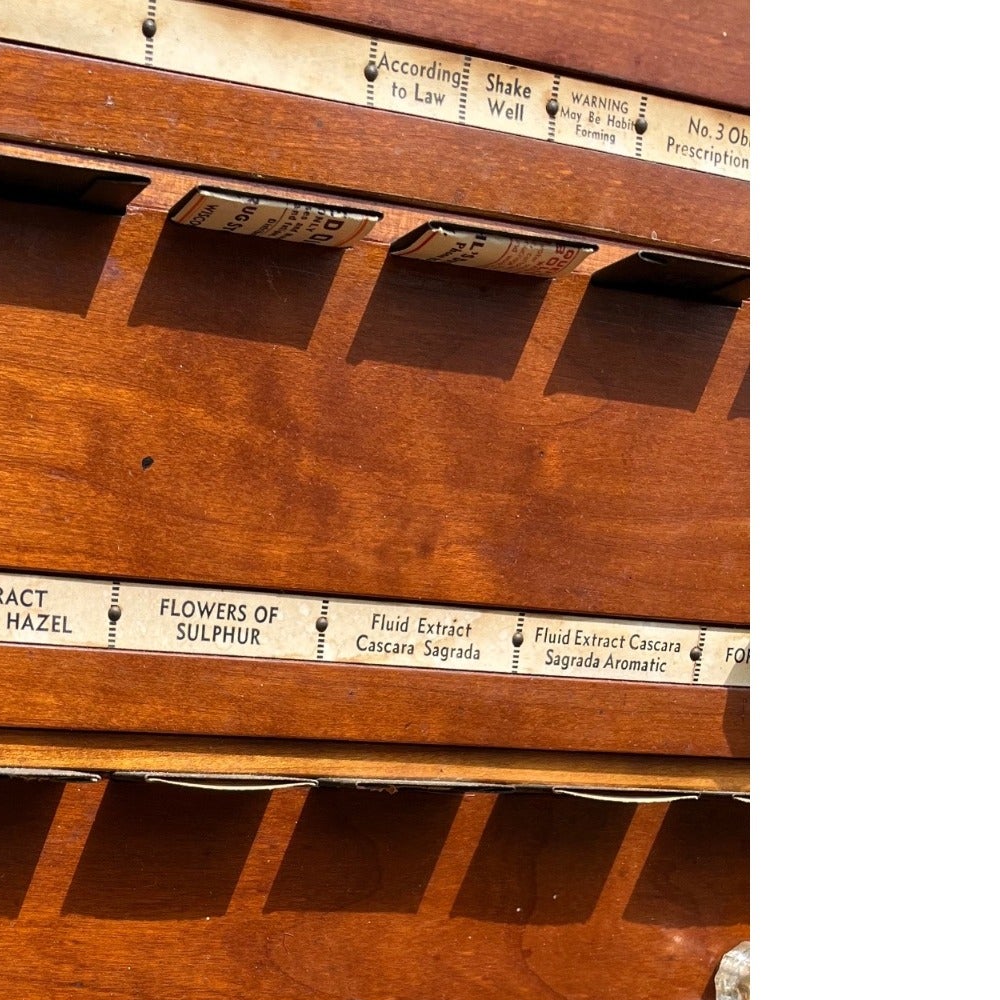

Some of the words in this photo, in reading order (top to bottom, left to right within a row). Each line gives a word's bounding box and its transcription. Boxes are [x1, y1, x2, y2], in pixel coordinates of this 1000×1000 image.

[377, 52, 462, 88] According
[392, 82, 407, 99] to
[415, 83, 445, 106] Law
[486, 73, 532, 98] Shake
[487, 98, 524, 121] Well
[572, 92, 628, 114] WARNING
[560, 106, 582, 123] May
[589, 111, 601, 125] Be
[607, 114, 636, 131] Habit
[576, 125, 616, 144] Forming
[688, 116, 712, 138] No.
[715, 123, 724, 140] 3
[728, 127, 750, 147] Ob
[667, 136, 749, 169] Prescription
[6, 612, 73, 634] HAZEL
[159, 598, 247, 622] FLOWERS
[254, 605, 280, 624] OF
[176, 623, 261, 646] SULPHUR
[371, 613, 409, 632] Fluid
[418, 617, 472, 637] Extract
[356, 634, 415, 655] Cascara
[424, 640, 481, 661] Sagrada
[535, 626, 571, 645] Fluid
[574, 630, 626, 649] Extract
[629, 634, 681, 653] Cascara
[545, 649, 600, 670] Sagrada
[603, 653, 667, 672] Aromatic
